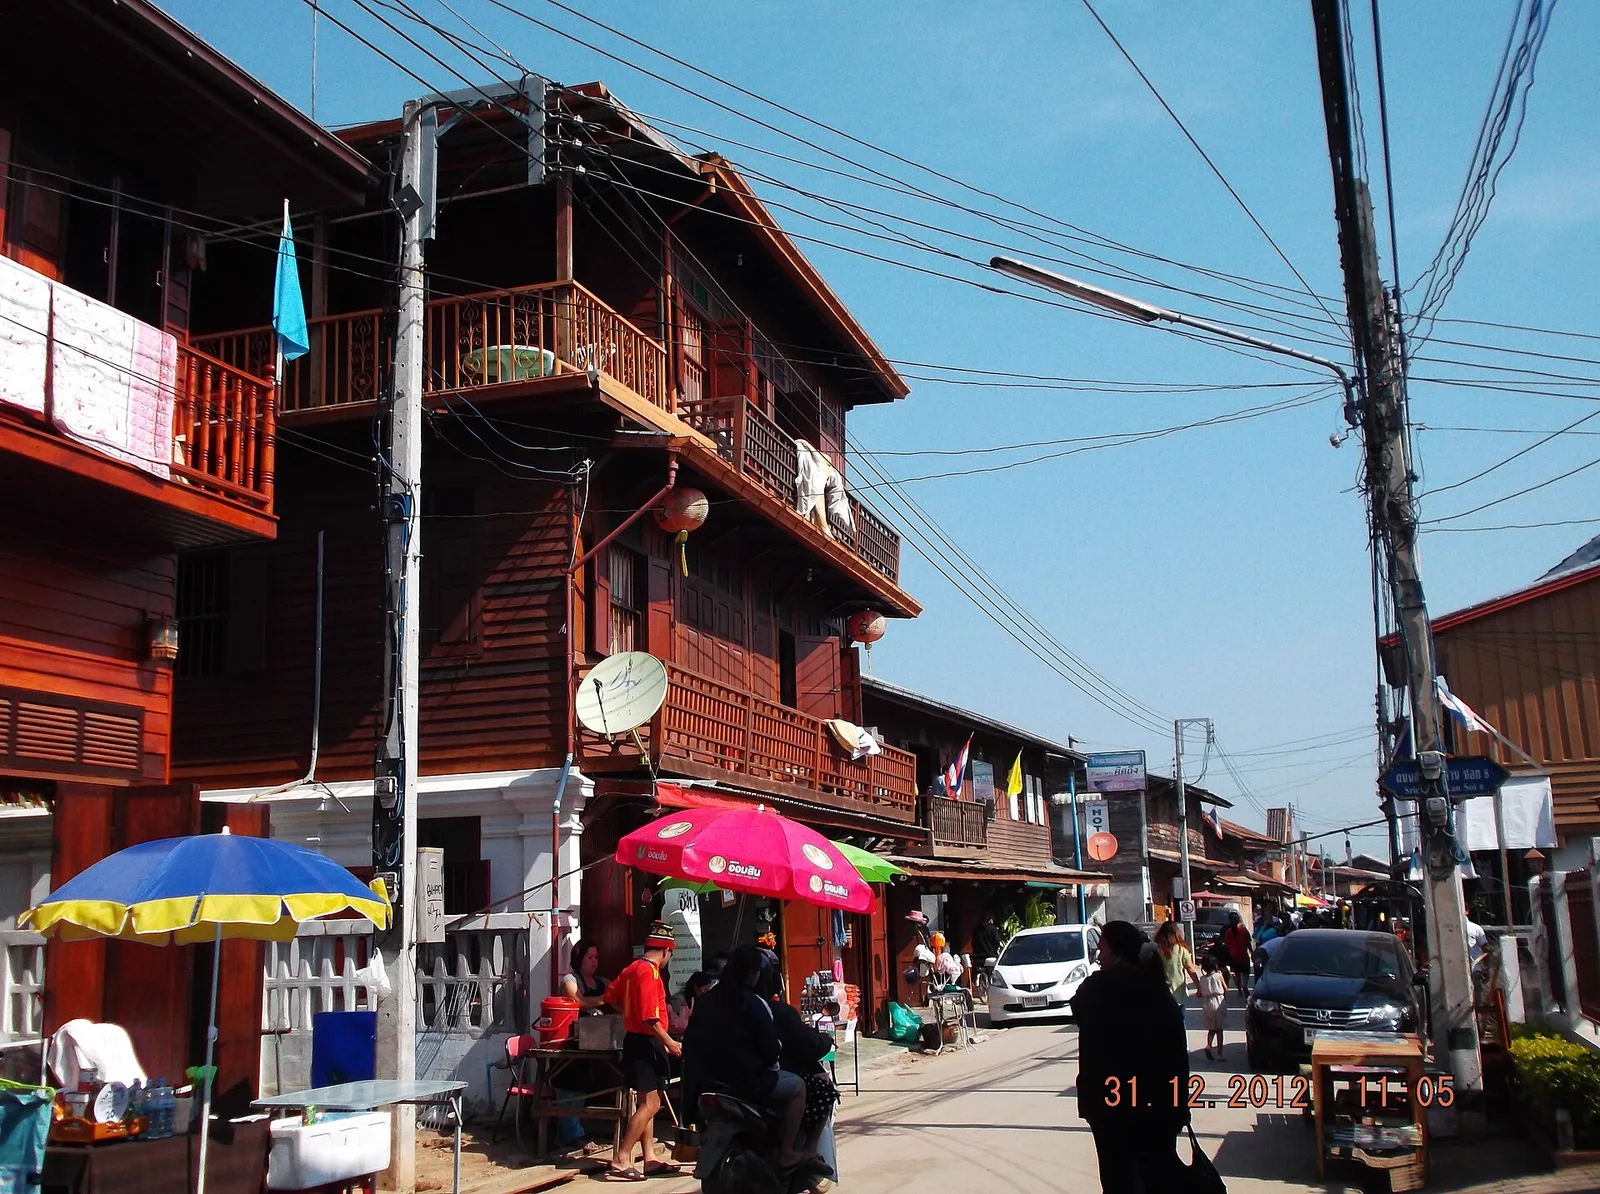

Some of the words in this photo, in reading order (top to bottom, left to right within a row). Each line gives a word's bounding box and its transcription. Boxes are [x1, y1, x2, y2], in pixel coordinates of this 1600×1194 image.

[1484, 768, 1490, 779] 8
[1404, 785, 1420, 795] Sric
[1463, 782, 1477, 791] Soi
[1092, 809, 1103, 832] HOT
[728, 864, 761, 877] ออมสิน
[824, 883, 848, 896] ออมสิน
